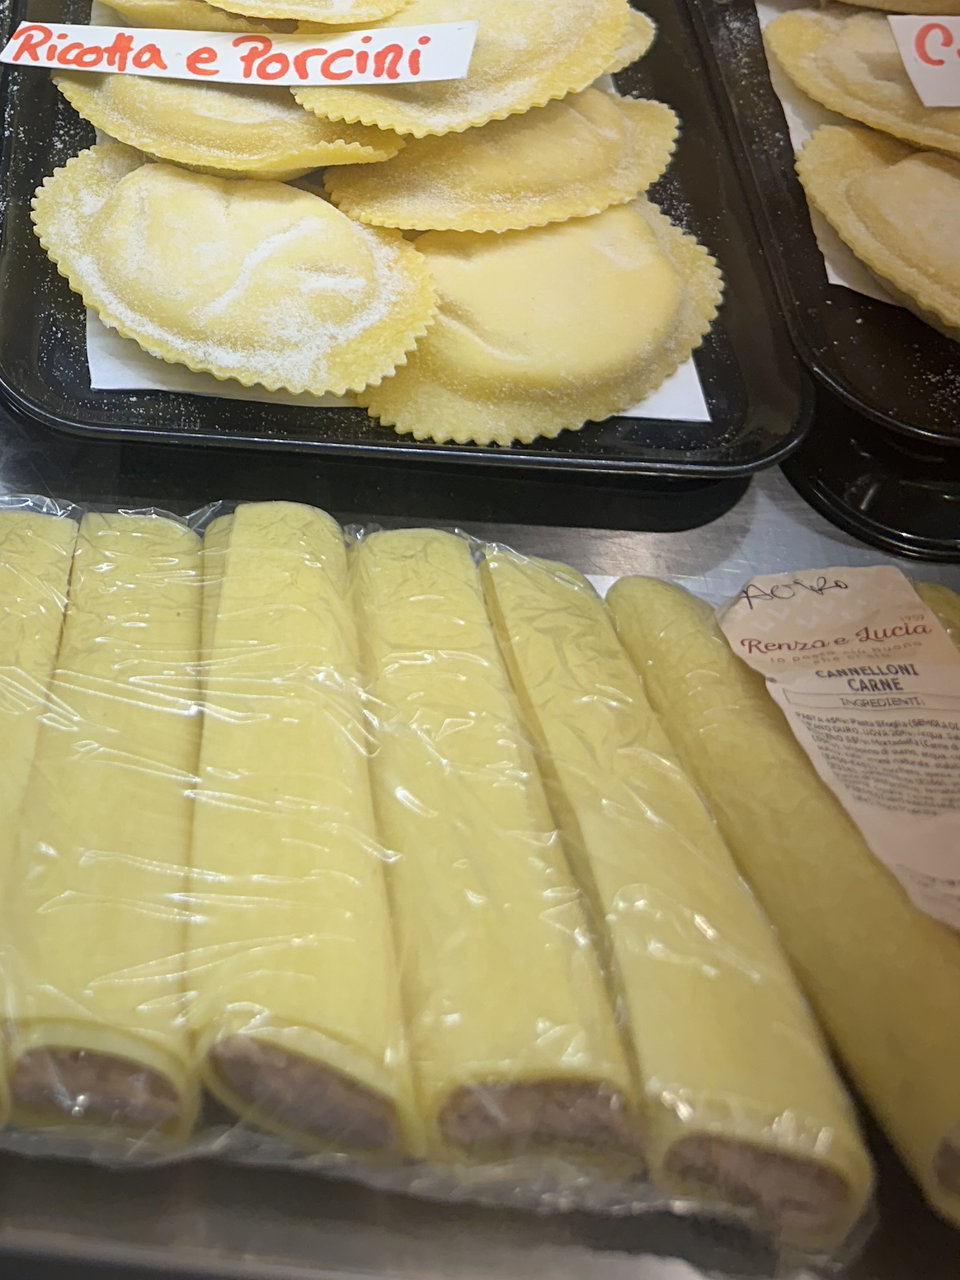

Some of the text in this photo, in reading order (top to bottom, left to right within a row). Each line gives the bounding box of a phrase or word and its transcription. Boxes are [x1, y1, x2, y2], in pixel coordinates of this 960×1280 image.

[12, 24, 432, 81] Ricotta e Porcini
[740, 622, 932, 654] Renzo e Lucia
[815, 663, 920, 679] CANNELLONI
[847, 678, 904, 693] CARNE
